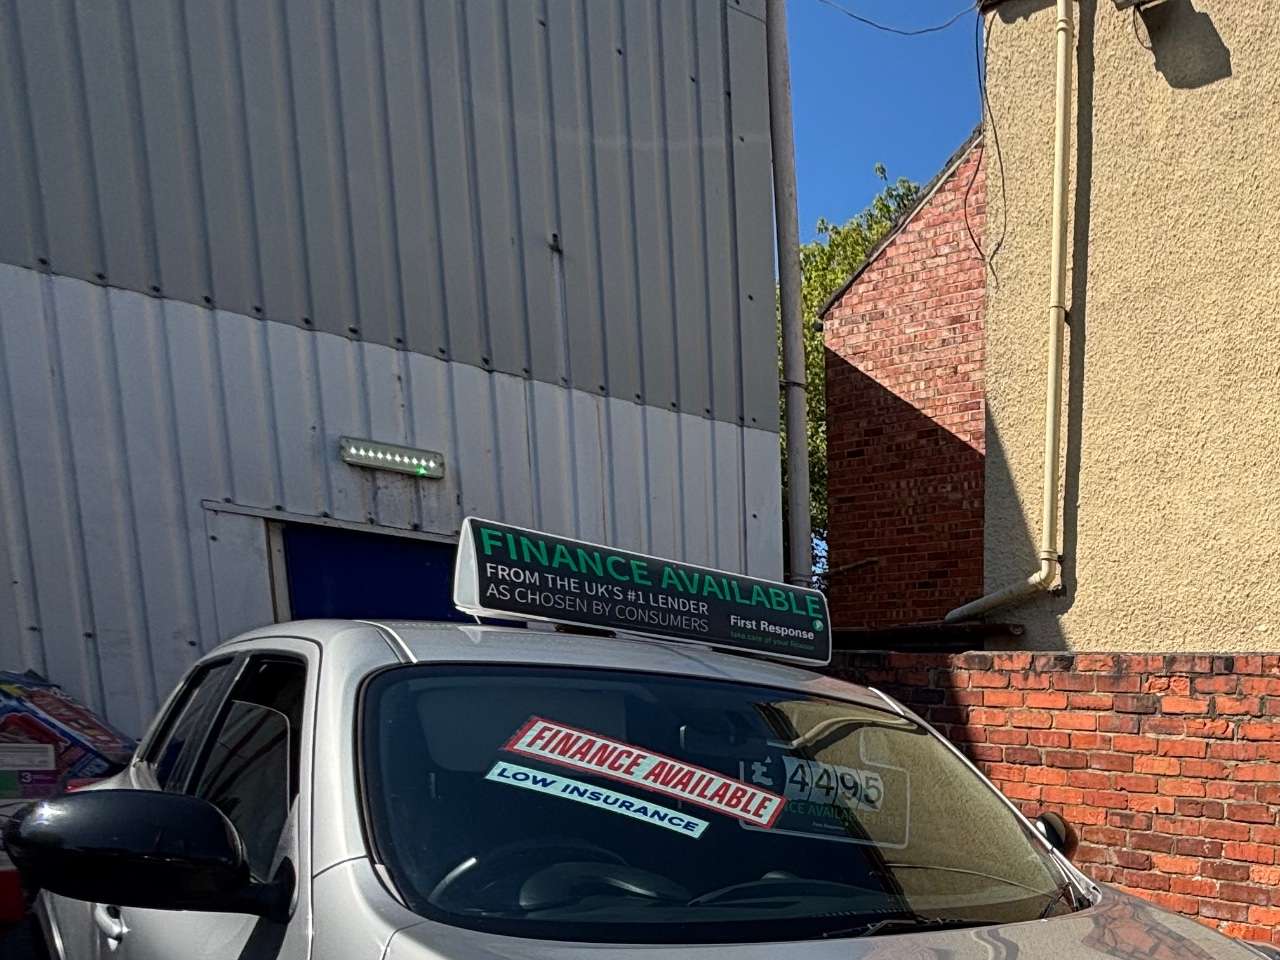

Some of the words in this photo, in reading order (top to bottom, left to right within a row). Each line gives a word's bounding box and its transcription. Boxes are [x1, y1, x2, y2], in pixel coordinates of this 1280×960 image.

[480, 528, 653, 586] FINANCE
[661, 566, 824, 618] AVAILABLE
[486, 563, 540, 586] FROM
[544, 573, 581, 593] THE
[627, 589, 647, 605] #1
[650, 593, 709, 616] LENDER
[486, 583, 511, 600] AS
[514, 588, 588, 613] CHOSEN
[592, 601, 612, 617] BY
[615, 605, 709, 633] CONSUMERS
[730, 615, 758, 630] First
[760, 620, 815, 640] Response
[526, 725, 648, 777] FINANCE
[643, 760, 773, 818] AVAILABLE
[788, 763, 882, 805] 4495
[497, 768, 558, 788] LOW
[561, 783, 700, 833] INSURANCE
